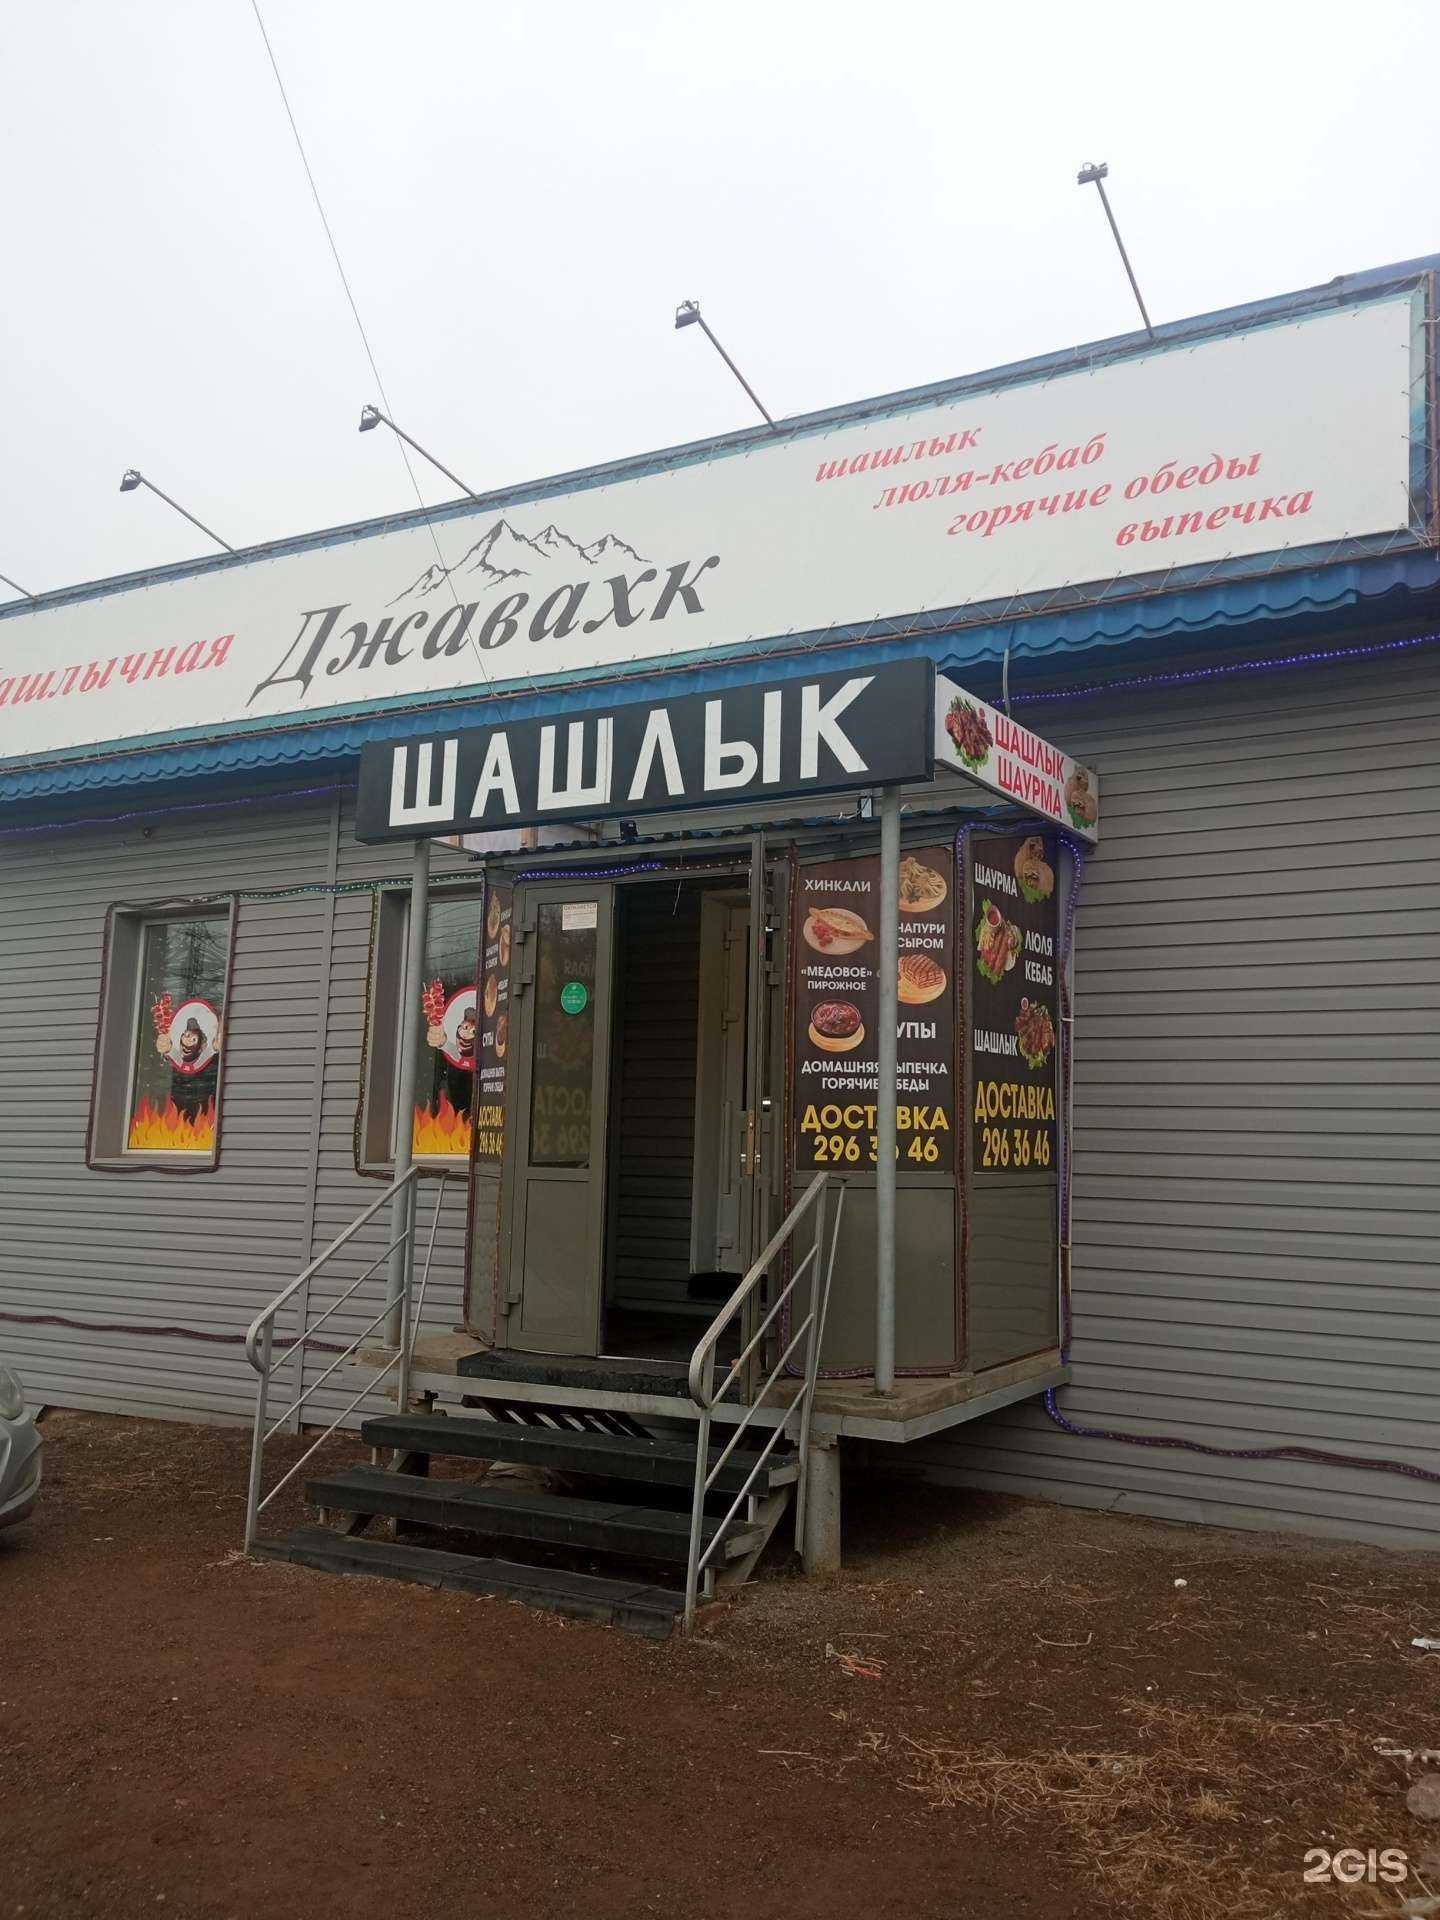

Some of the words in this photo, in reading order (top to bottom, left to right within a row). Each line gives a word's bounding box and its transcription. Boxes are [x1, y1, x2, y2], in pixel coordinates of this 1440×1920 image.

[815, 426, 983, 482] шашлык
[872, 433, 1107, 509] люля-кебаб
[947, 482, 1113, 538] горячие
[1123, 452, 1263, 500] обеды
[1115, 488, 1314, 547] выпечка
[246, 555, 720, 706] Джавахк
[0, 633, 235, 709] ашлычная
[388, 675, 876, 828] ШАШЛЫК
[994, 714, 1065, 785] ШАШЛЫК
[997, 755, 1062, 819] ШАУРМА
[804, 879, 871, 892] ХИНКАЛИ
[973, 862, 1019, 898] ШАУРМА
[1024, 930, 1053, 957] ЛЮЛЯ
[807, 980, 867, 991] ПИРОЖНОЕ
[1025, 959, 1053, 986] КЕБАБ
[897, 1021, 937, 1039] УПЫ
[974, 1028, 1018, 1057] ШАШЛЫК
[801, 1060, 879, 1074] ДОМАШНЯЯ
[897, 1061, 948, 1075] ЫПЕЧКА
[822, 1077, 879, 1090] ГОРЯЧИЕ
[897, 1078, 930, 1092] БЕДЫ
[801, 1104, 950, 1133] ДОСТВКА
[974, 1081, 1055, 1124] ДОСТАВКА
[813, 1135, 860, 1162] 296
[907, 1136, 939, 1162] 46
[982, 1128, 1009, 1166] 296
[1013, 1129, 1030, 1166] 36
[1033, 1130, 1050, 1166] 46
